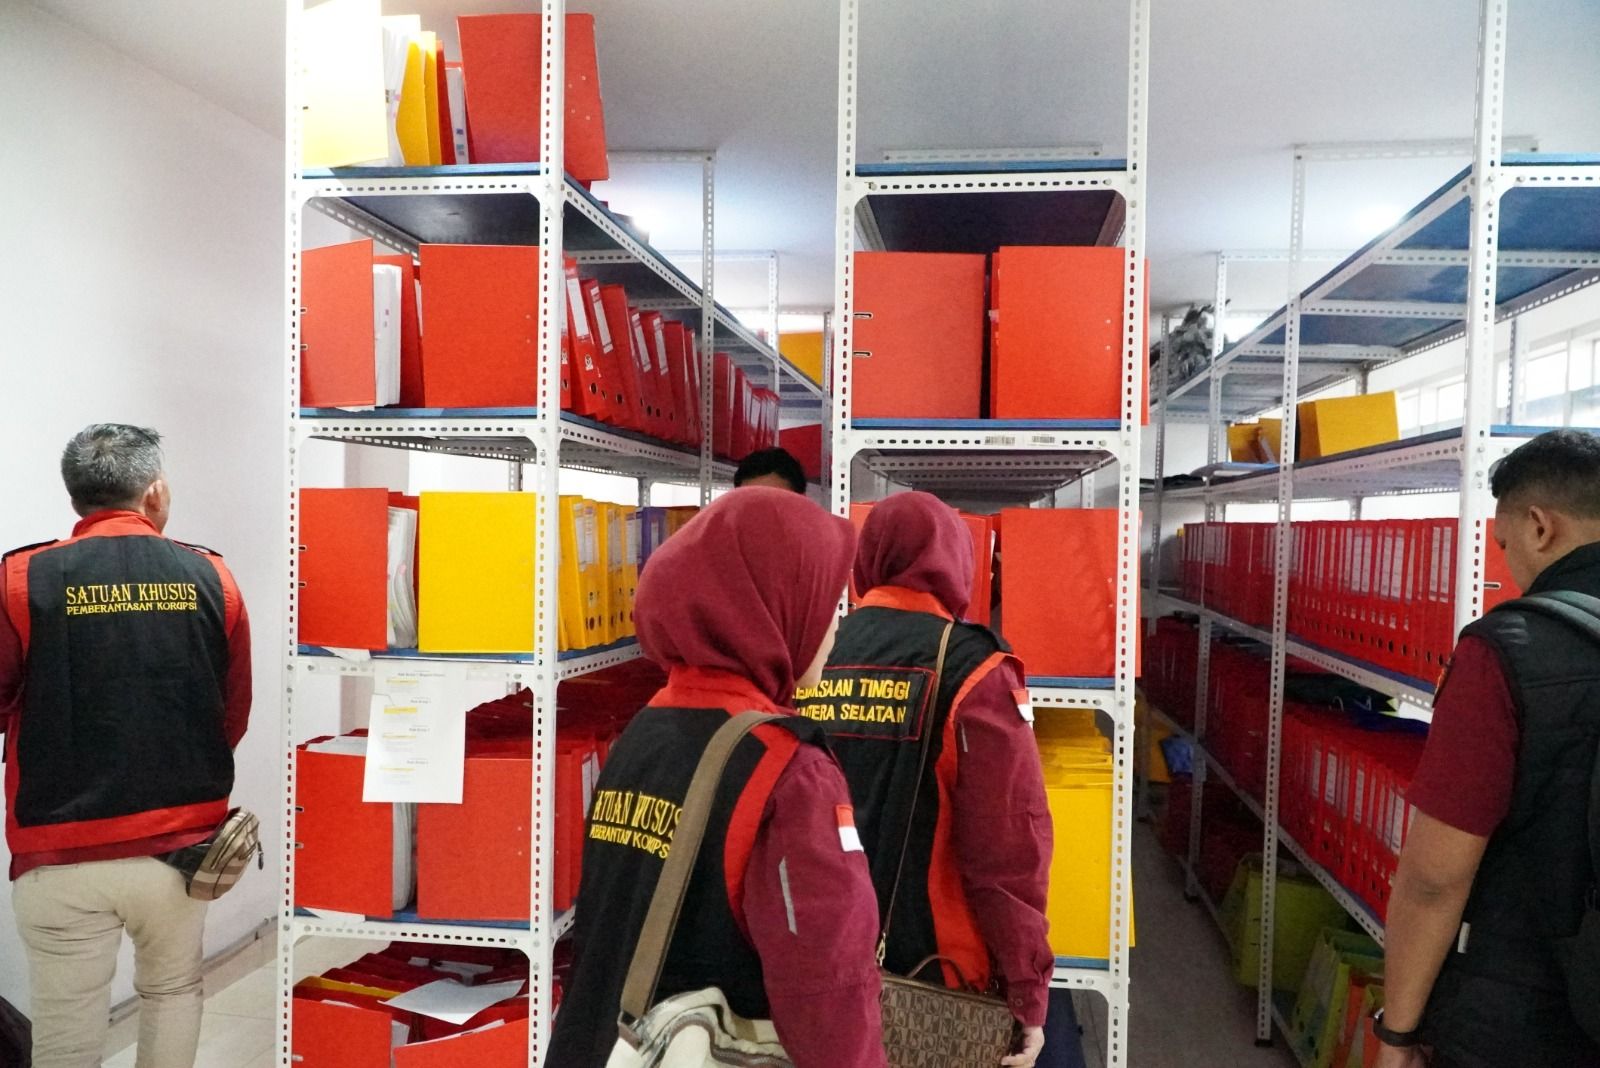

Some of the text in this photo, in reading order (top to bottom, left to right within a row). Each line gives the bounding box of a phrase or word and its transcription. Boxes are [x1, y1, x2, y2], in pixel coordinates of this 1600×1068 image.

[66, 583, 197, 605] SATUAN KHUSUS
[66, 601, 197, 615] PEMBERANTASAN KORUPSI
[860, 678, 911, 700] TINGGI
[840, 703, 906, 723] SELATAN
[592, 790, 634, 825] ATUAN
